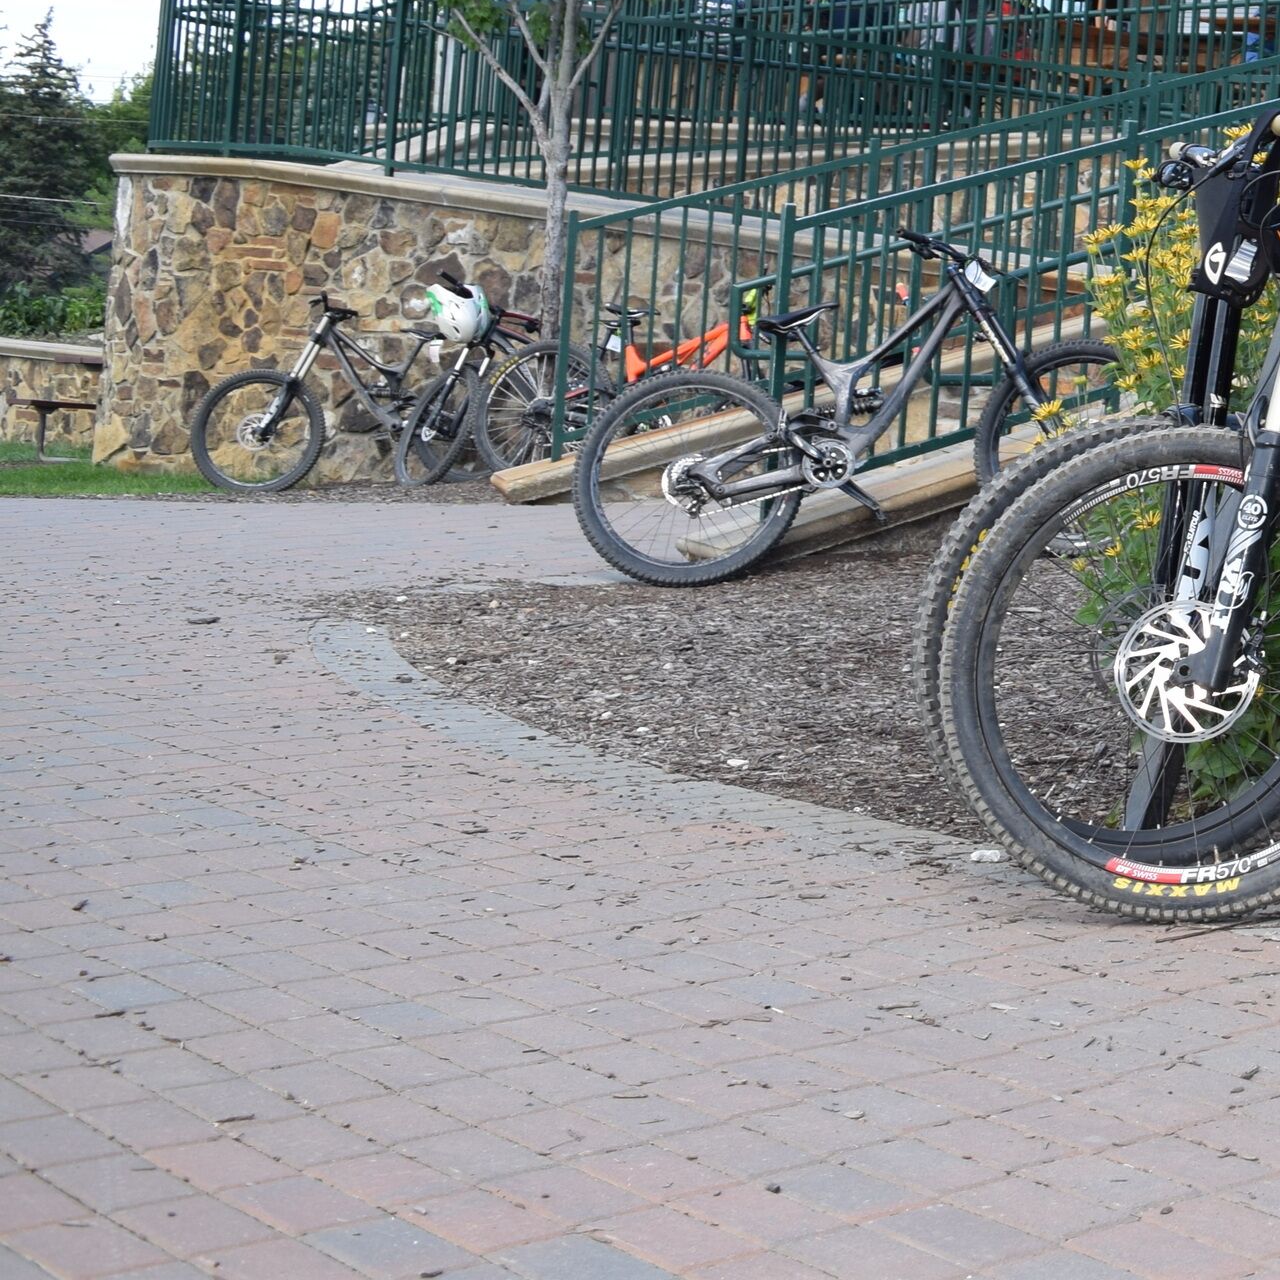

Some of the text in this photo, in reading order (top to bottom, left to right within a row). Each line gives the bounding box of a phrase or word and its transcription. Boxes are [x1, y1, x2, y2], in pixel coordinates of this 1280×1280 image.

[1243, 501, 1261, 515] 40
[1187, 510, 1201, 543] SUNTOUR
[1210, 557, 1244, 630] FOX
[1131, 868, 1158, 881] SWISS
[1180, 857, 1252, 884] FR570
[1112, 877, 1241, 898] MAXXIS
